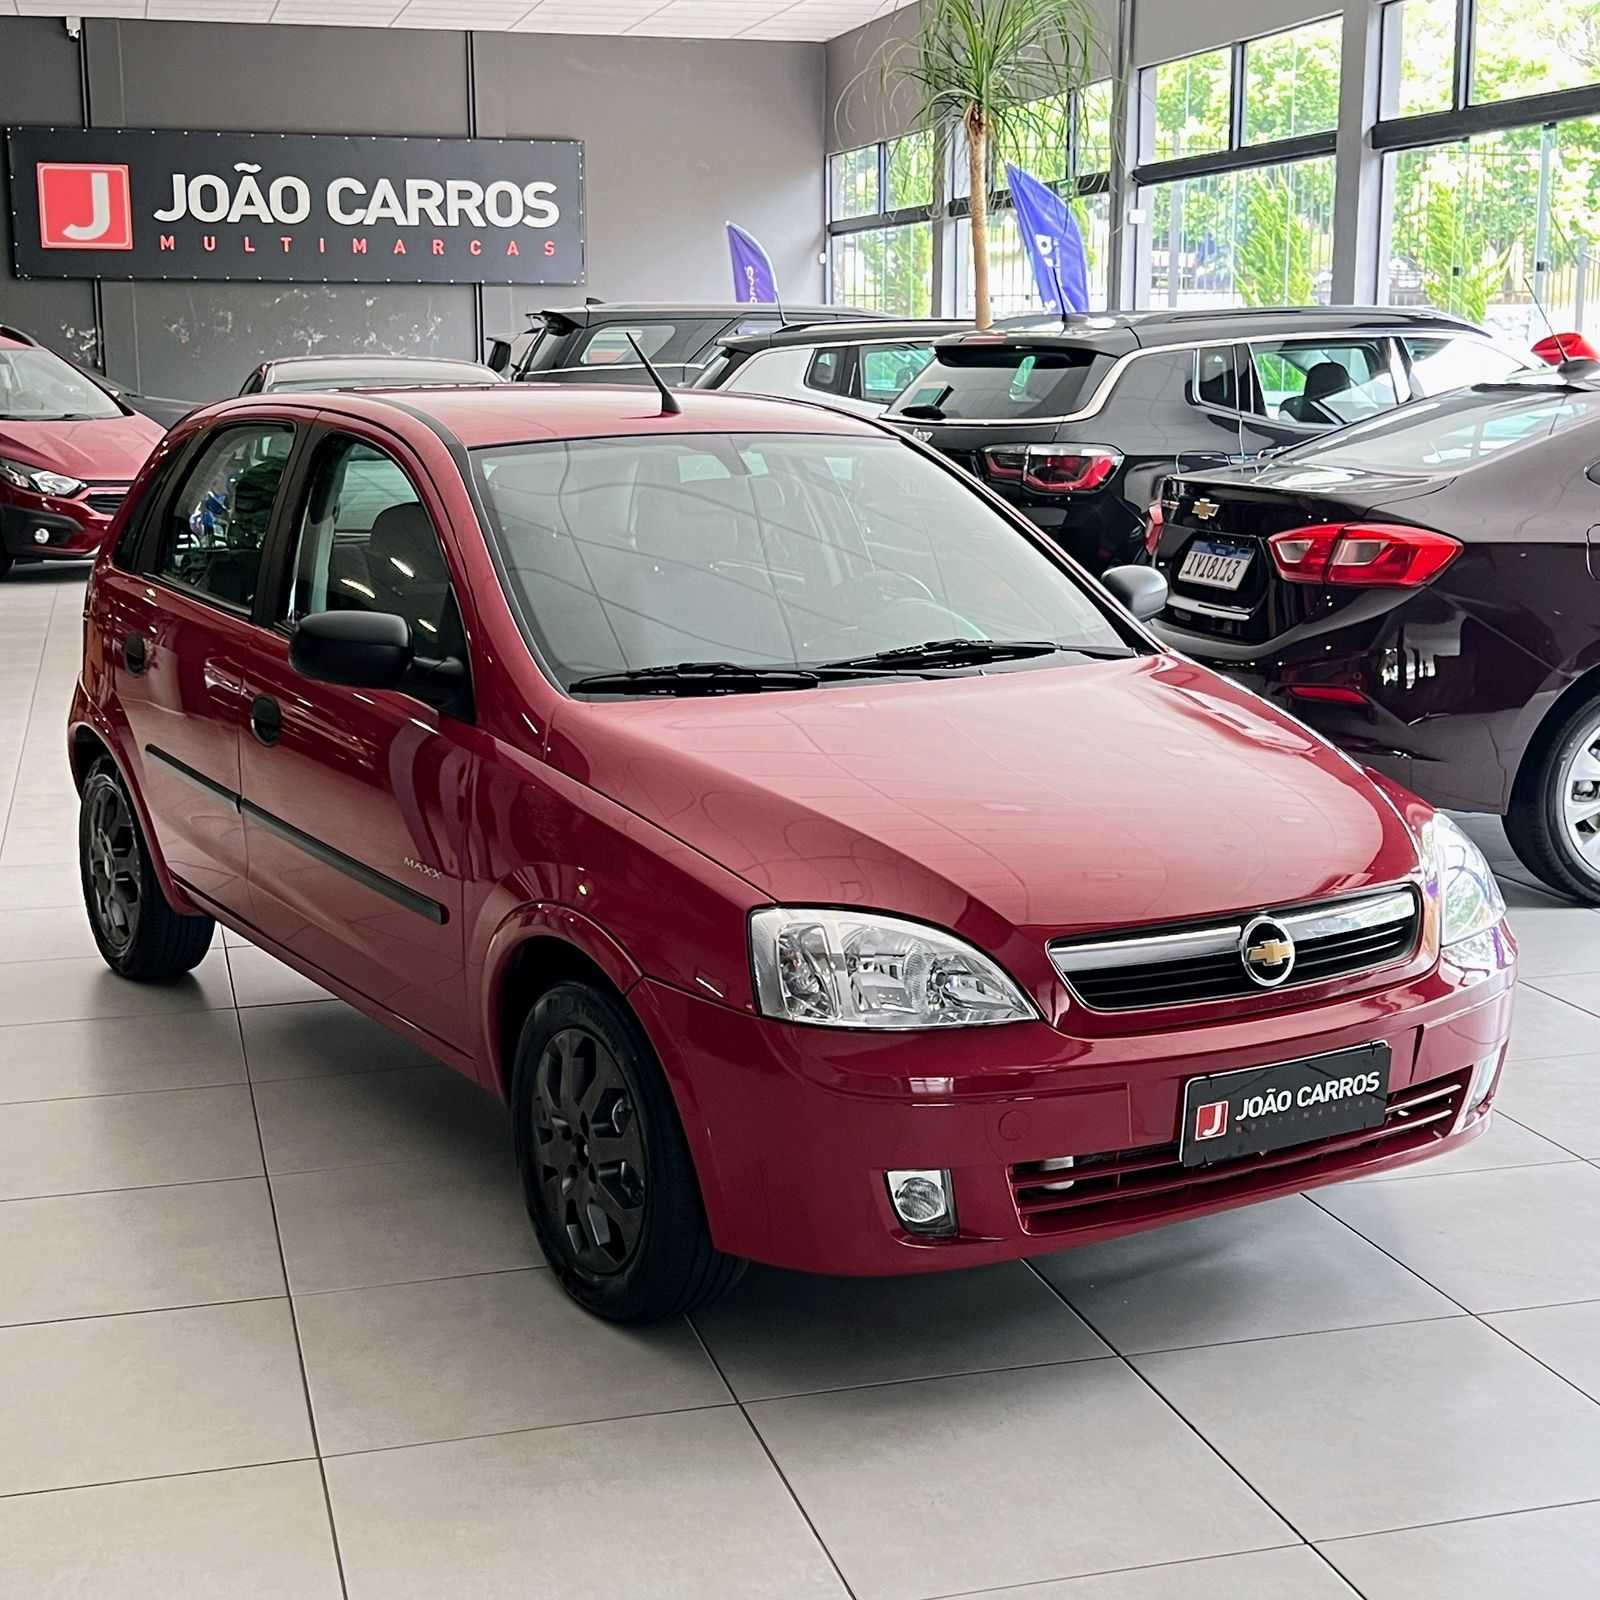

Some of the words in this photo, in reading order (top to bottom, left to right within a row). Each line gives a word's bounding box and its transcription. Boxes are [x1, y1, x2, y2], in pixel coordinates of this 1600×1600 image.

[62, 172, 111, 241] J
[154, 162, 311, 224] JOÃO
[327, 177, 560, 228] CARROS
[160, 235, 556, 257] MULTIMARCAS
[404, 856, 442, 879] MAXX
[1235, 1088, 1292, 1121] JOÃO
[1296, 1071, 1380, 1107] CARROS
[1202, 1103, 1223, 1137] J
